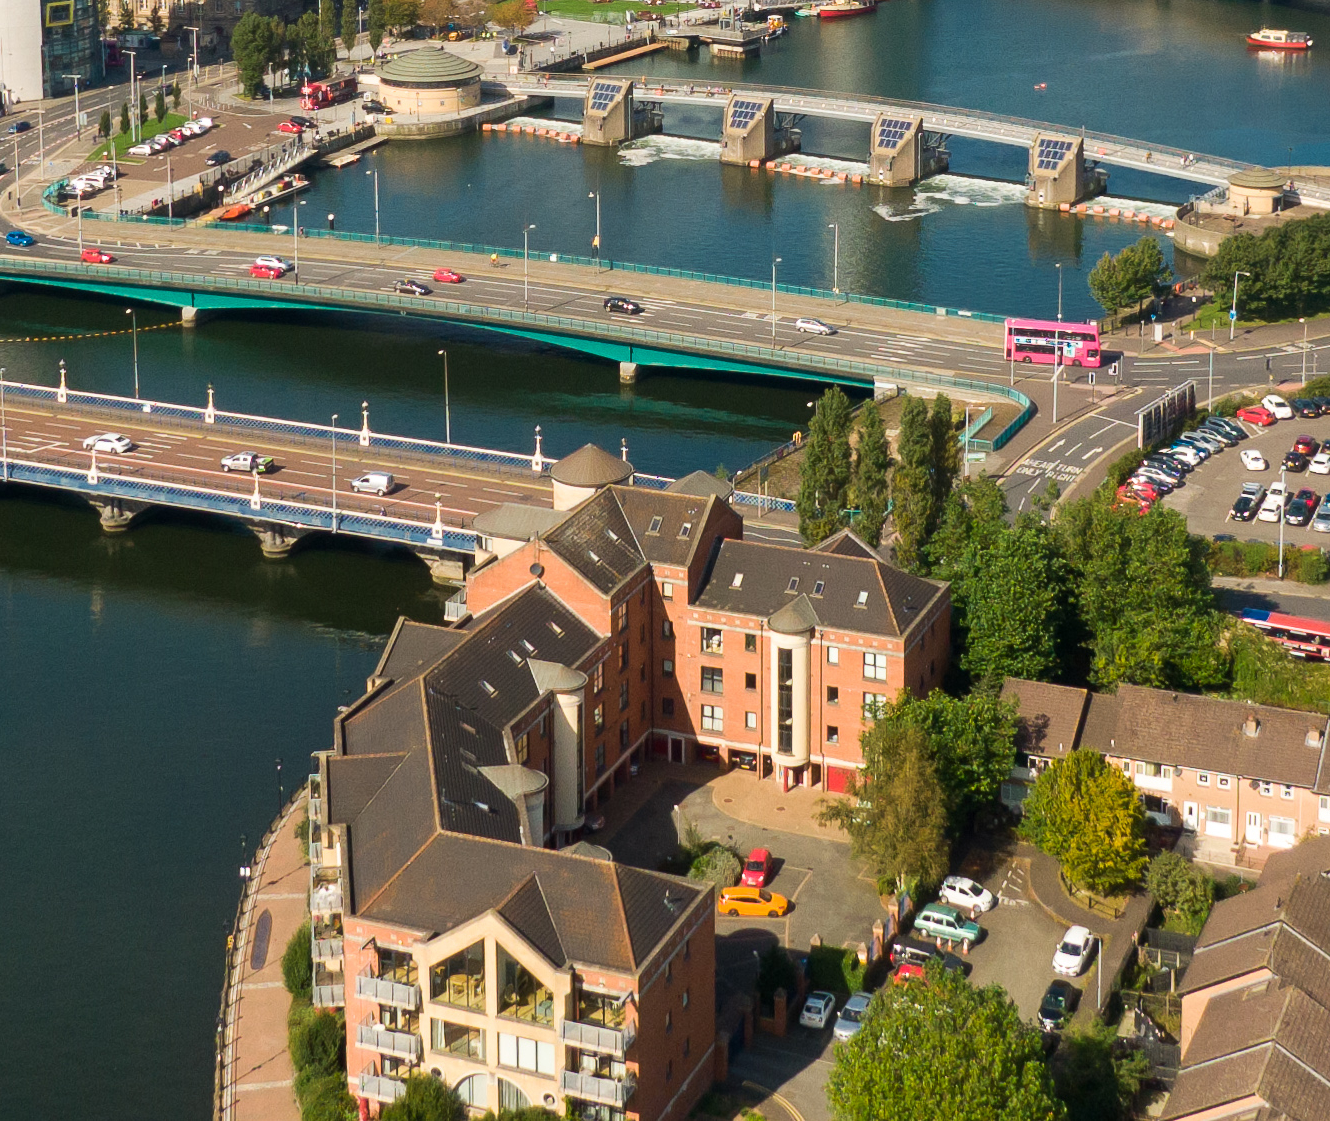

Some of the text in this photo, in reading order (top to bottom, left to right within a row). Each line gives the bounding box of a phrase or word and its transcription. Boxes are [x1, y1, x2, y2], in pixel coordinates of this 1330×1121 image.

[1021, 459, 1055, 469] AHEAD
[1056, 464, 1083, 474] TURN
[1016, 467, 1043, 476] ONLY
[1045, 471, 1076, 482] RIGHT
